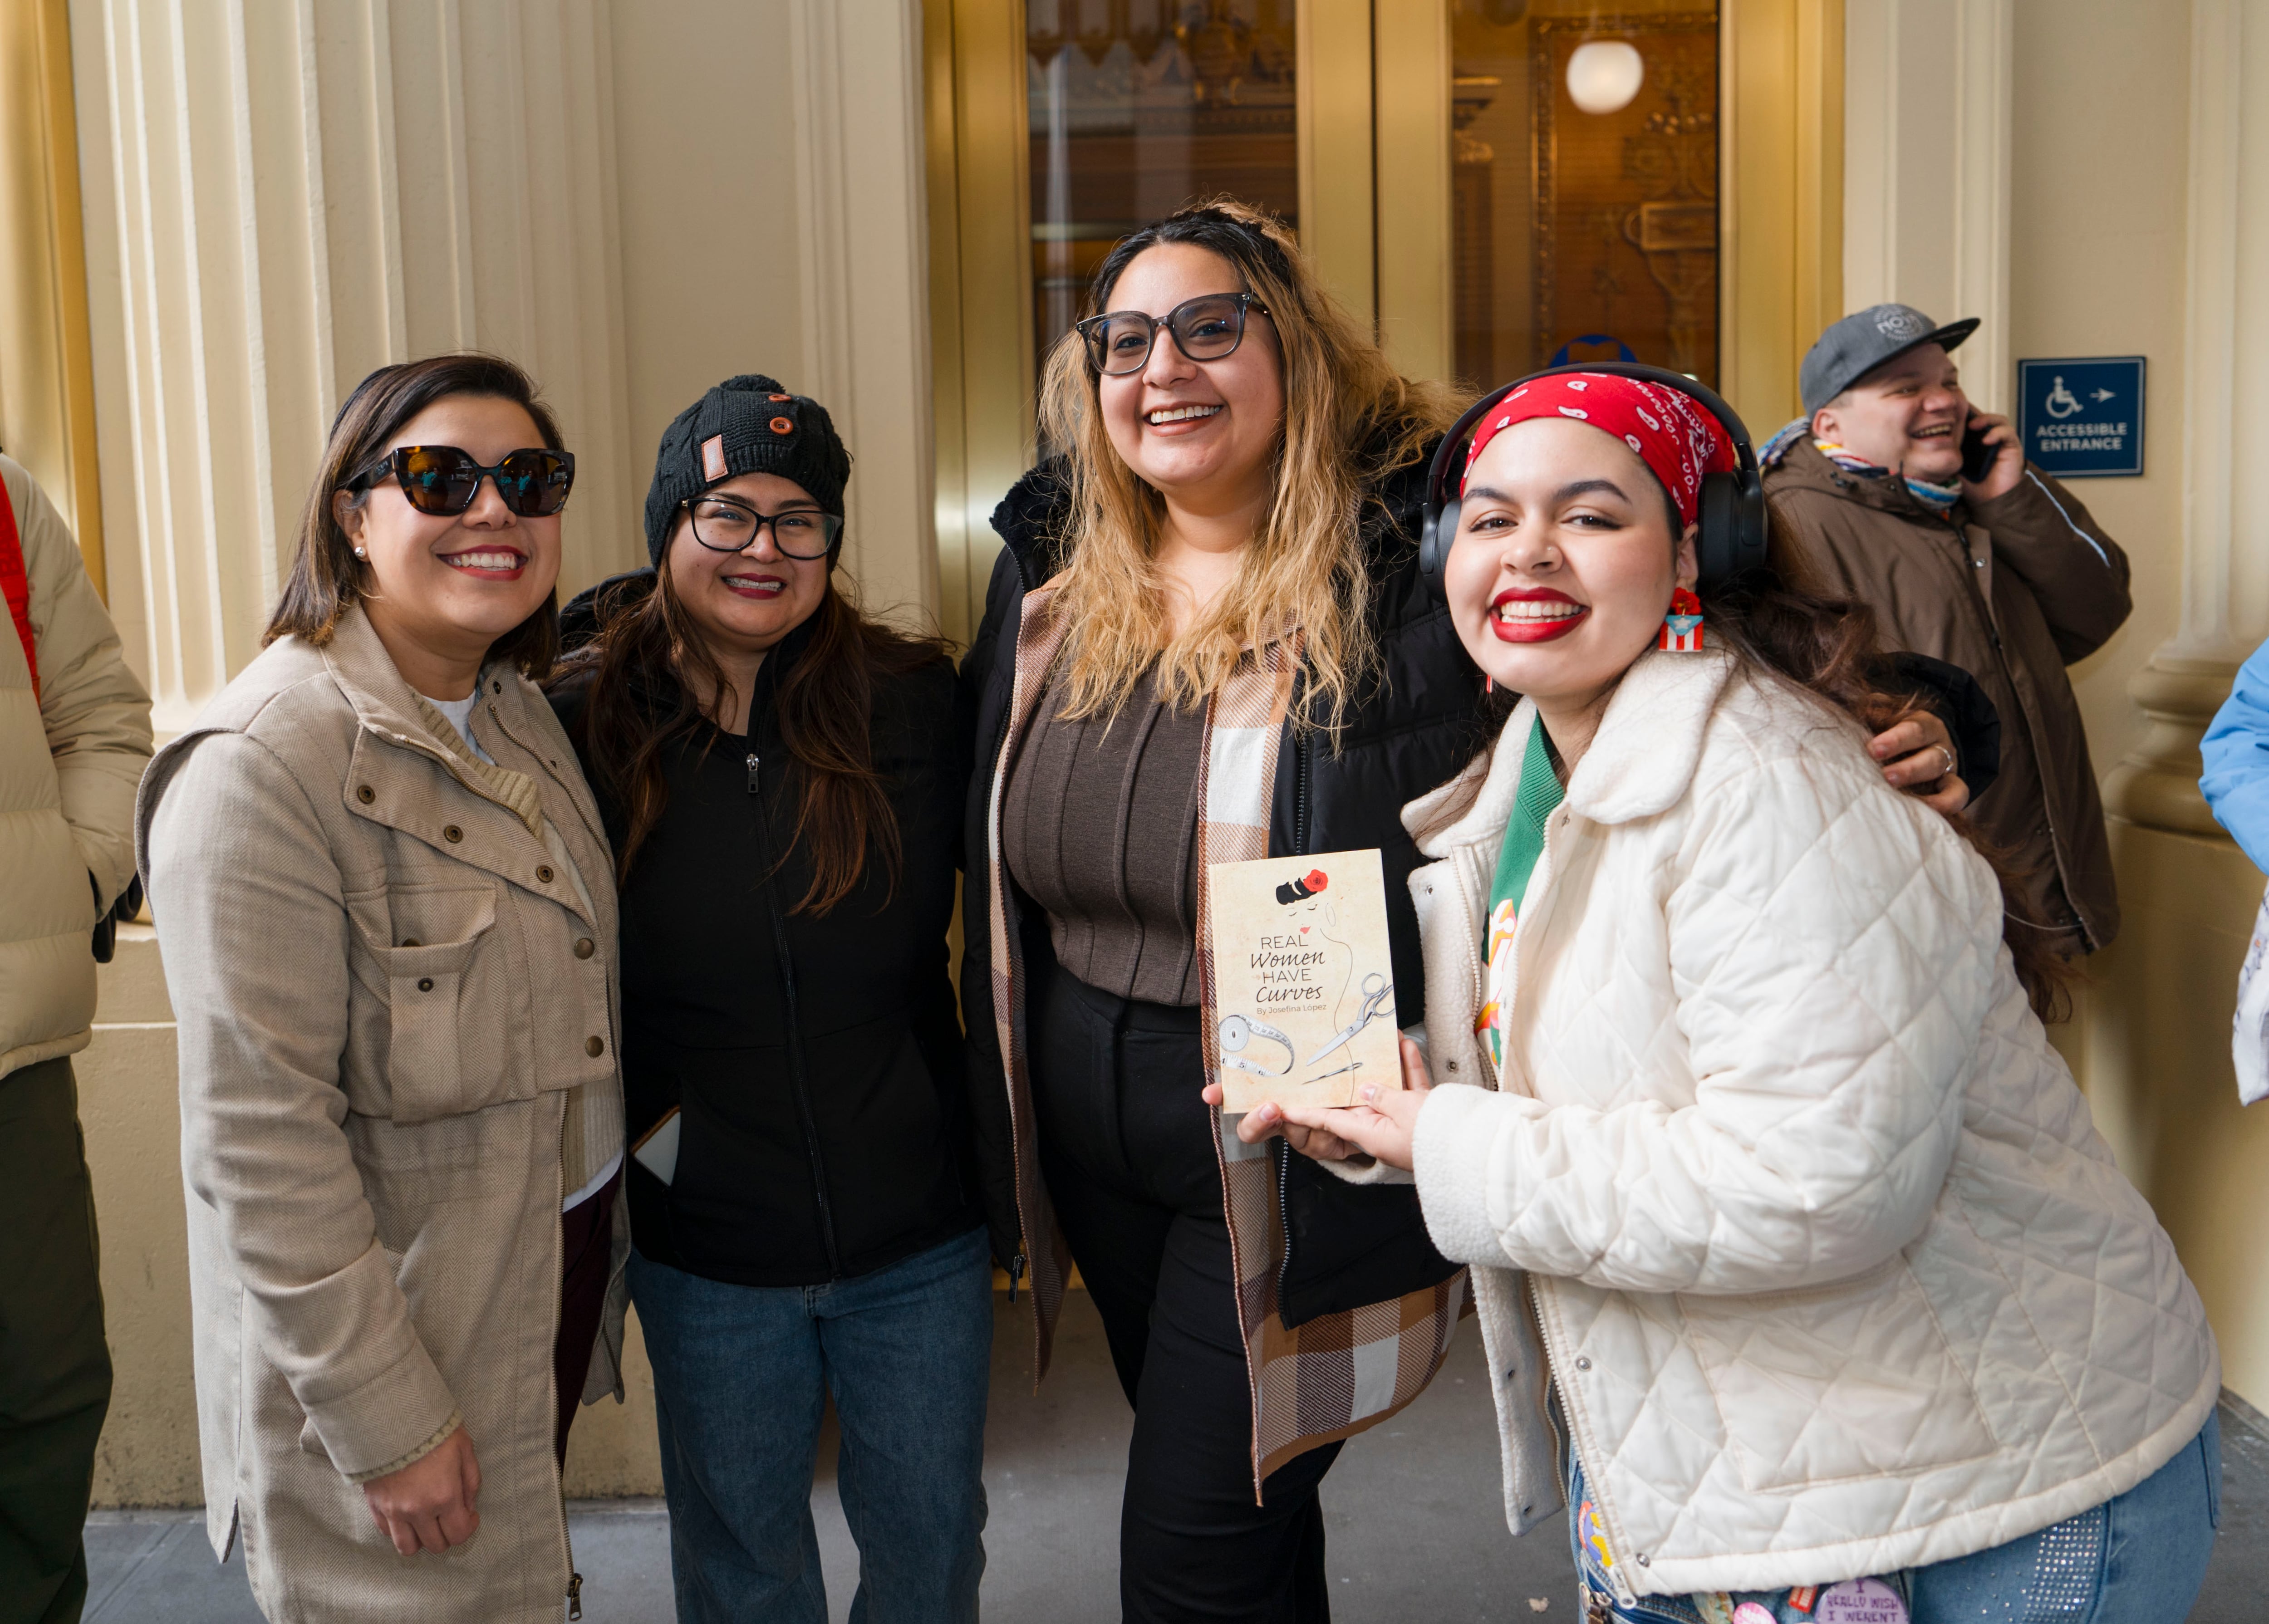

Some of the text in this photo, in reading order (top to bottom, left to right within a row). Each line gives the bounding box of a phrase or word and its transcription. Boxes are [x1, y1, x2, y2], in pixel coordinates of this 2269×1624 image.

[2036, 422, 2127, 437] ACCESSIBLE
[2041, 437, 2122, 451] ENTRANCE
[1261, 935, 1308, 949] REAL
[1251, 951, 1326, 969] Women
[1263, 968, 1311, 984] HAVE
[1256, 986, 1323, 1002] Curves
[1268, 1005, 1301, 1014] Josefina
[1303, 1004, 1326, 1013] López
[1856, 1579, 1864, 1593] I
[1870, 1596, 1899, 1609] WISH
[1828, 1610, 1835, 1621] I
